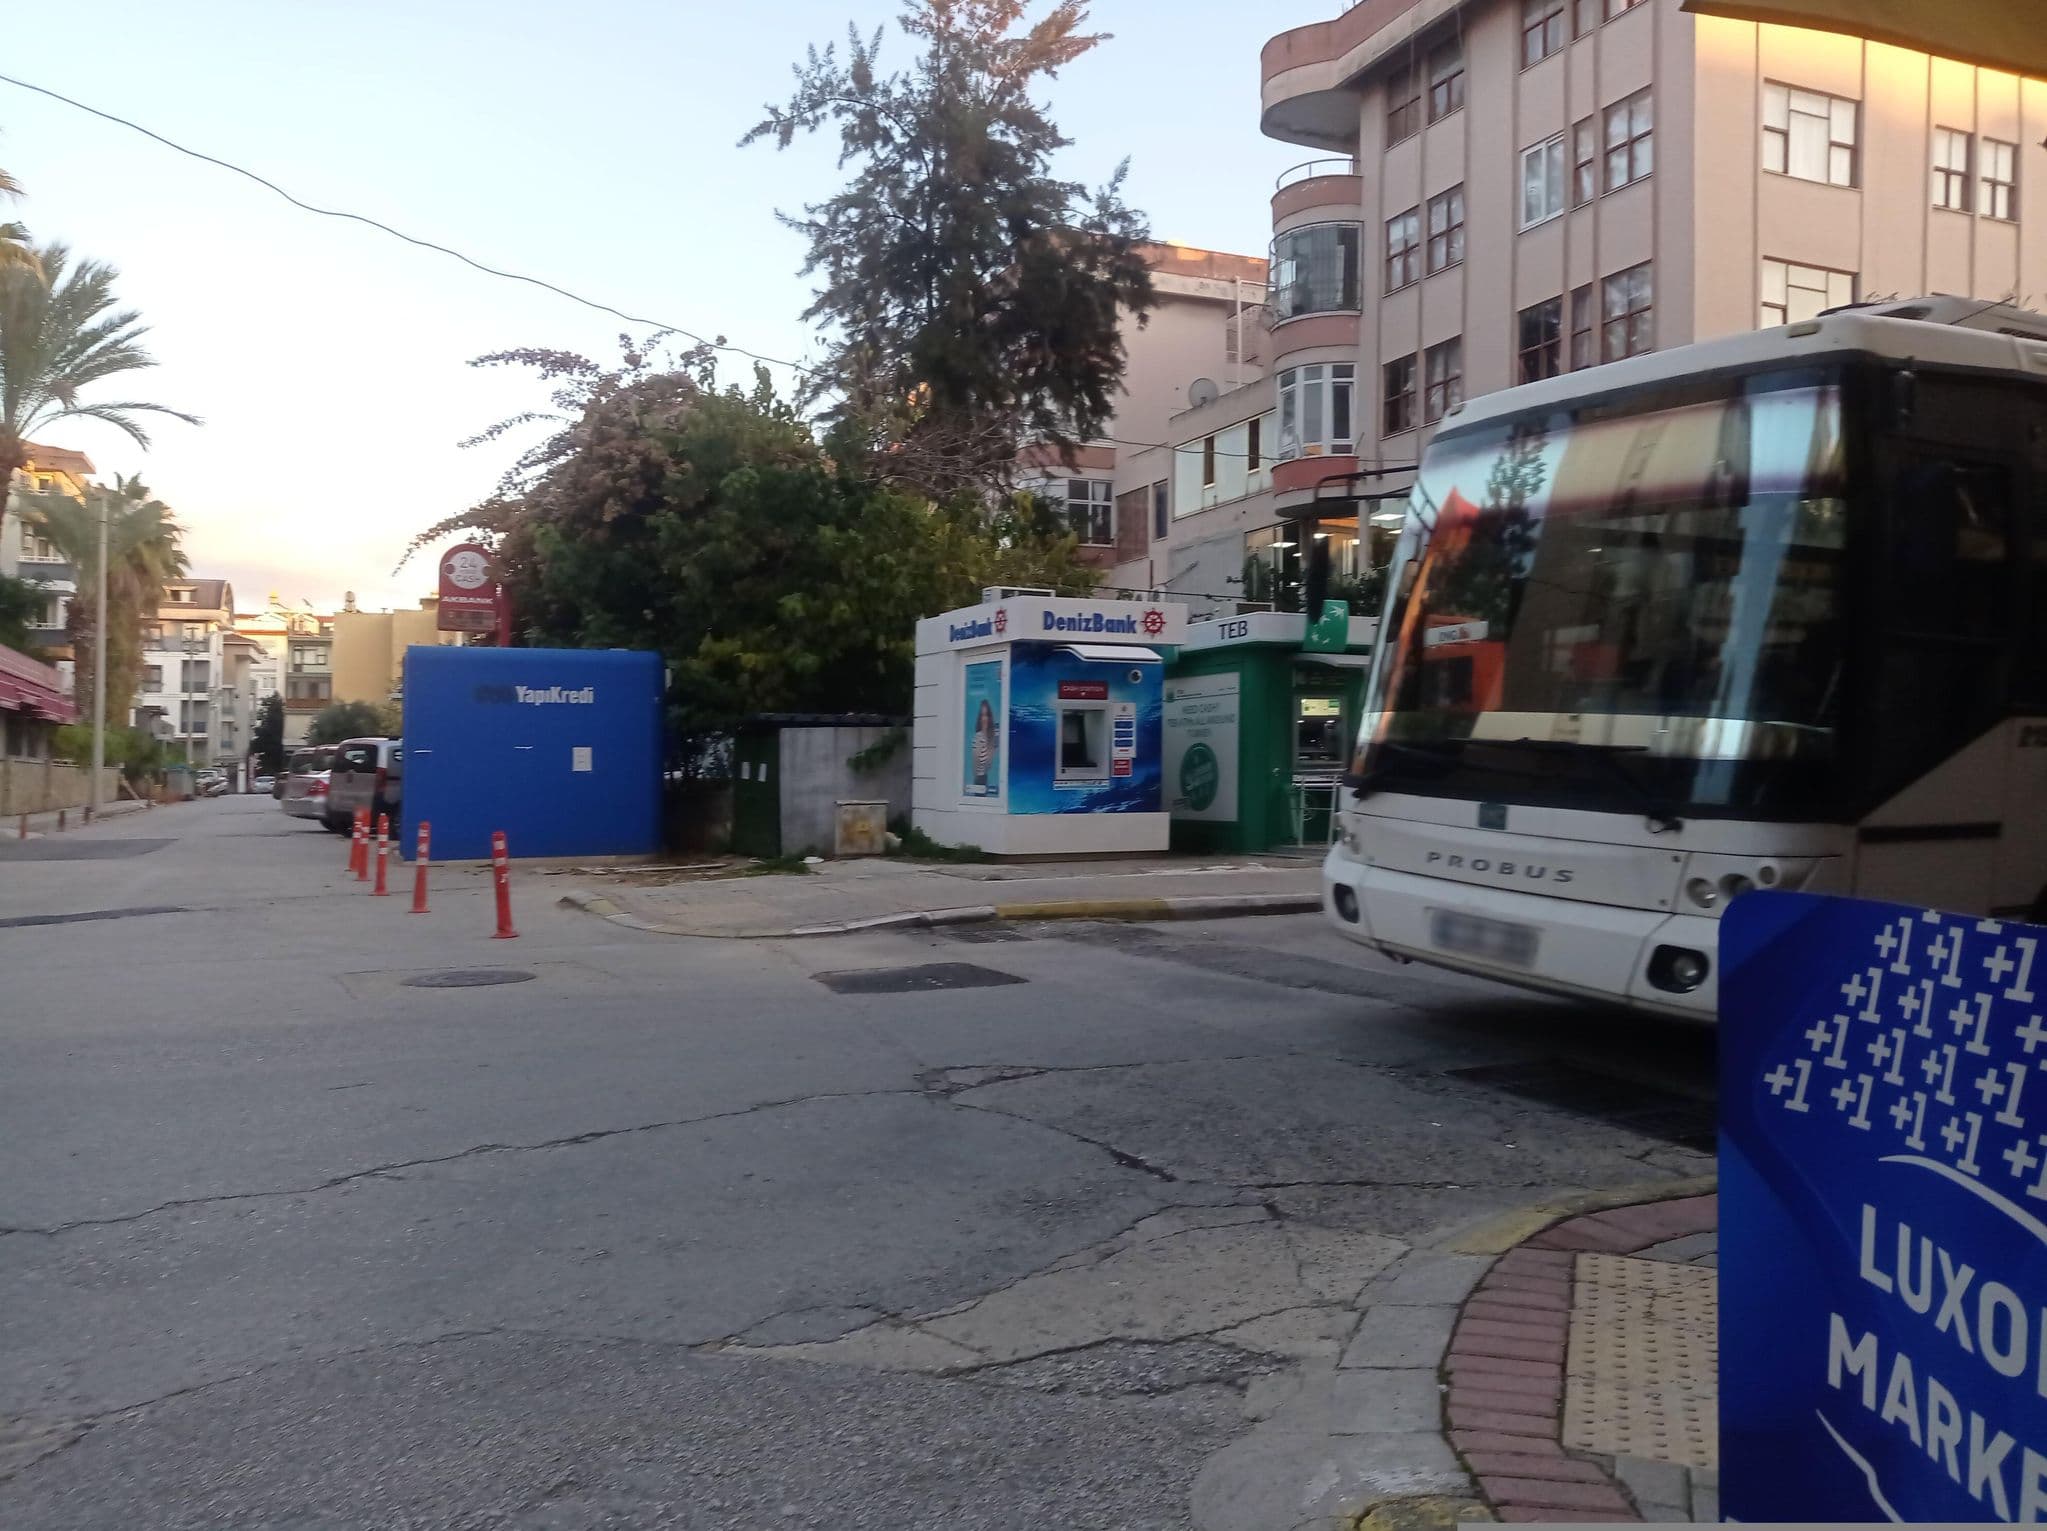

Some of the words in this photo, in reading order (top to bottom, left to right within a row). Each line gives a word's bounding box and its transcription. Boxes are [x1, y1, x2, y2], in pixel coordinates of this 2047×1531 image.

[950, 617, 992, 642] DenizBank
[1042, 610, 1137, 634] DenizBank
[1218, 620, 1248, 640] TEB
[1426, 851, 1575, 883] PROBUS
[1874, 917, 1913, 976] +1
[1926, 926, 1964, 988] +1
[1983, 937, 2037, 1003] +1
[1841, 967, 1883, 1024] +1
[1897, 978, 1934, 1039] +1
[1948, 992, 1993, 1057] +1
[1805, 1014, 1850, 1070] +1
[1867, 1028, 1906, 1086] +1
[1920, 1044, 1957, 1106] +1
[1975, 1062, 2027, 1128] +1
[1764, 1058, 1812, 1113] +1
[1830, 1073, 1874, 1131] +1
[1889, 1091, 1927, 1152] +1
[1940, 1111, 1983, 1177] +1
[1860, 1203, 2047, 1399] LUXO
